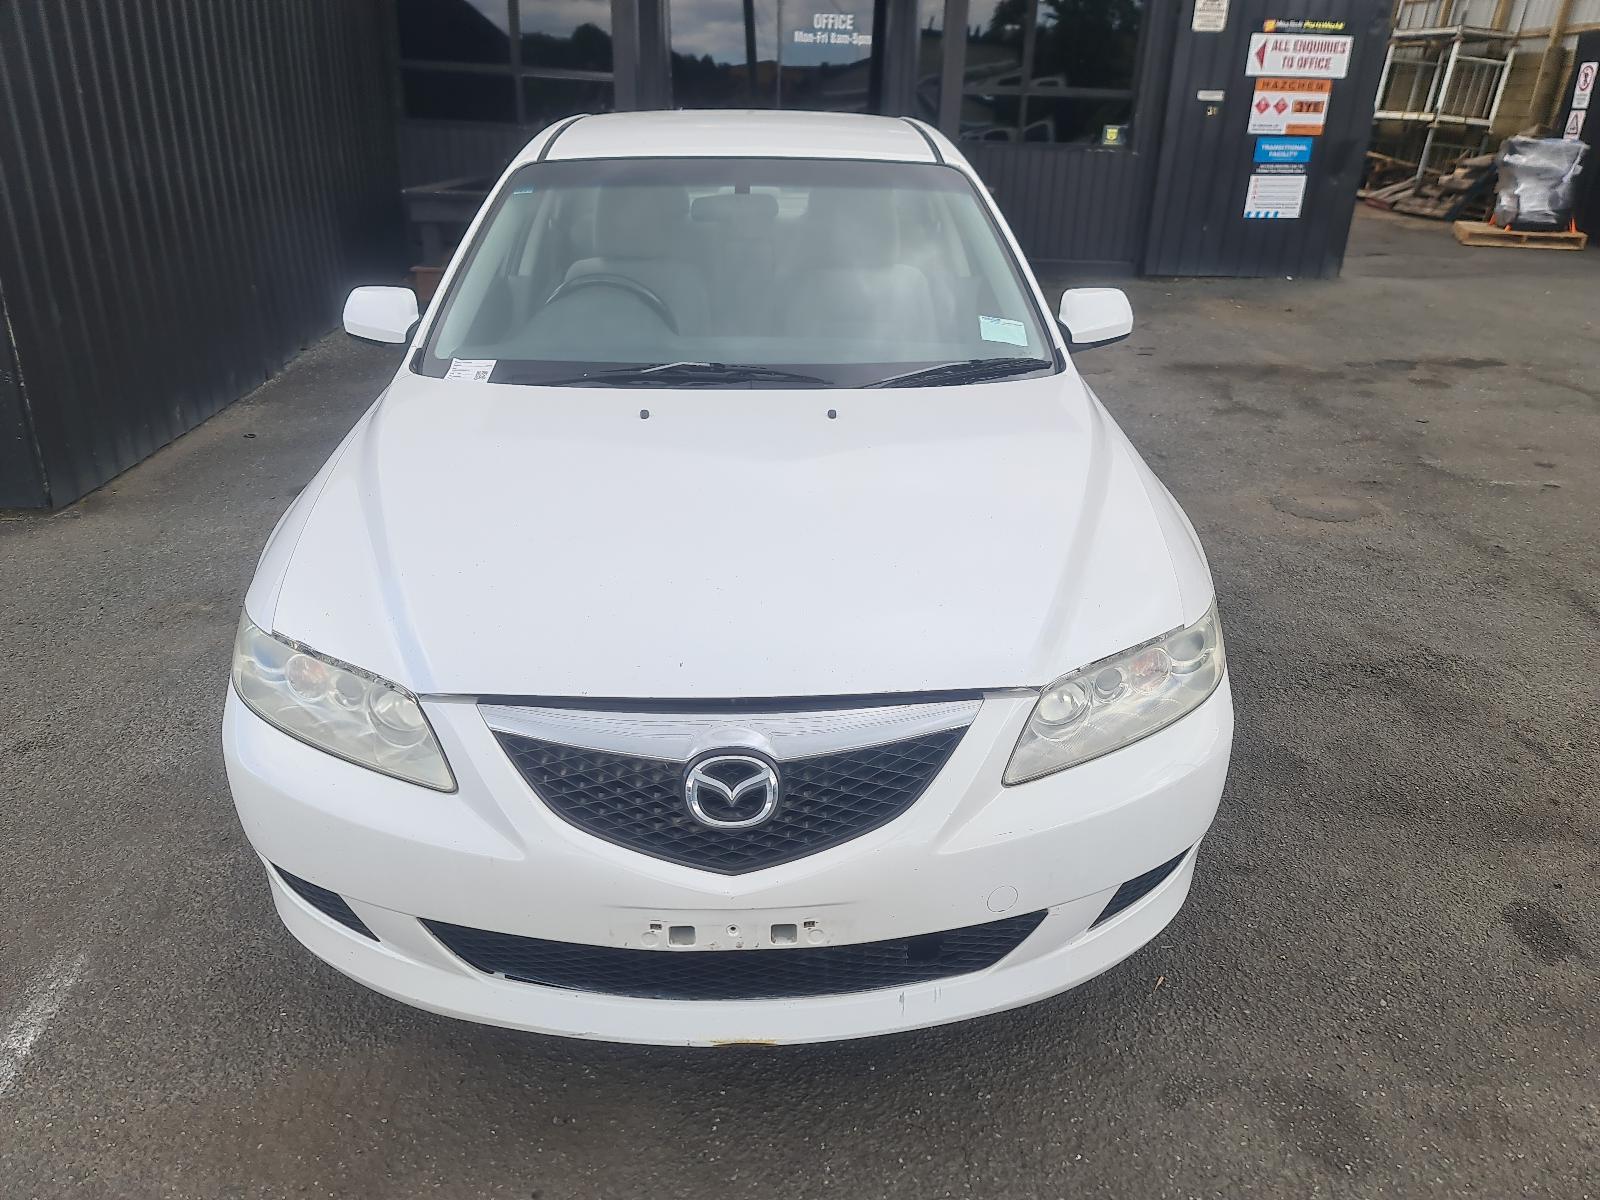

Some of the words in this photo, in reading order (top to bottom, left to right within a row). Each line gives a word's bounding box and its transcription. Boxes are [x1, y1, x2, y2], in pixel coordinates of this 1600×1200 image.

[814, 13, 855, 30] OFFICE
[1271, 40, 1290, 52] ALL
[1293, 40, 1347, 54] ENQUIRIES
[1281, 56, 1295, 69] TO
[1296, 56, 1333, 70] OFFICE
[1260, 80, 1325, 91] HAZCHEM
